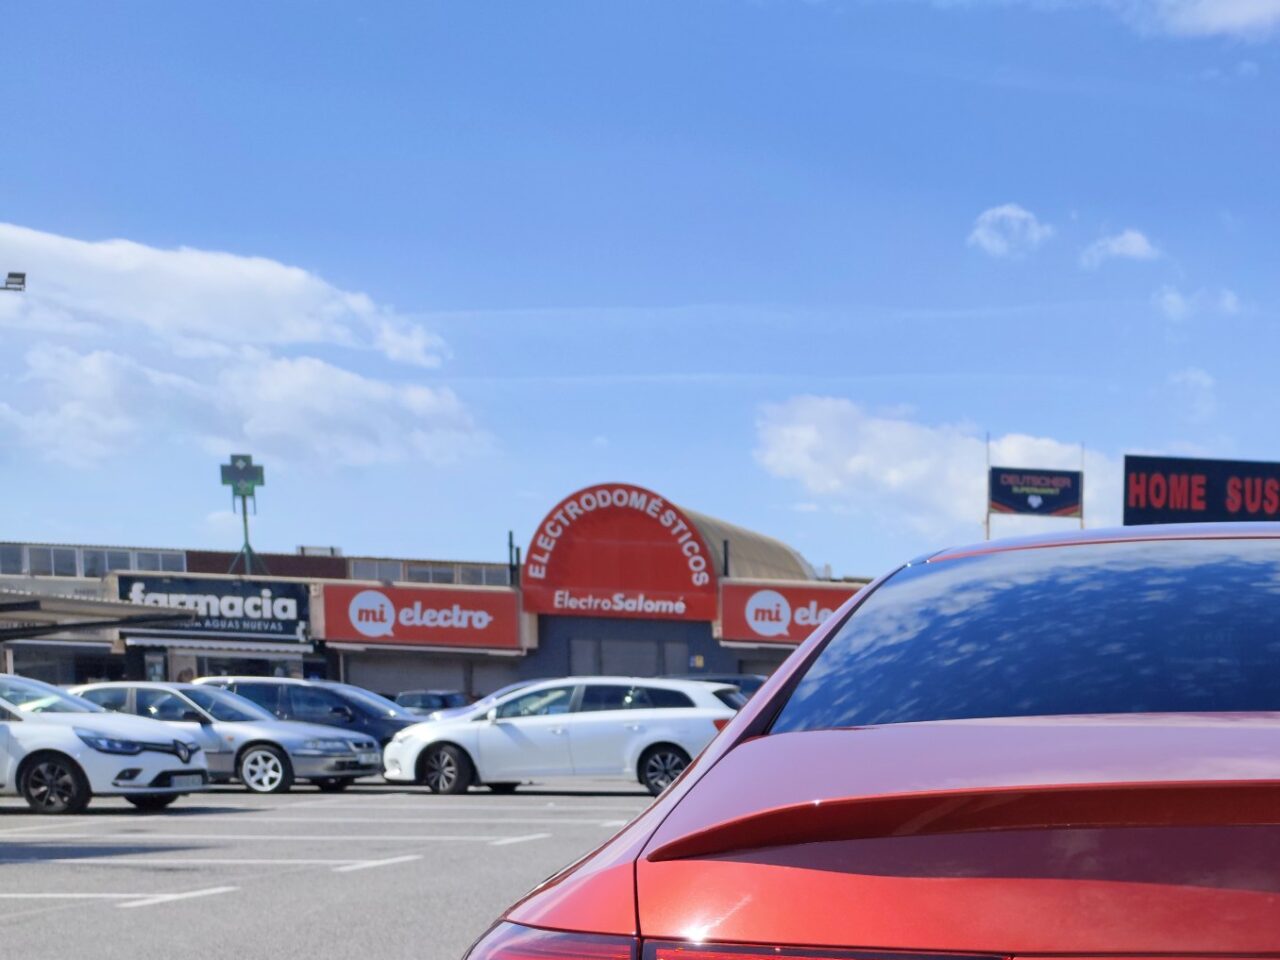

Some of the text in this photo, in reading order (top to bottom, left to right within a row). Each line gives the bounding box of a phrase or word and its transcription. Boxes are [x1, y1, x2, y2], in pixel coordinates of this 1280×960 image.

[1128, 472, 1206, 511] HOME
[528, 488, 709, 586] ELECTRODOMÉSTICOS
[129, 582, 297, 620] farmacia
[357, 601, 493, 629] mi electro
[553, 590, 687, 614] ElectroSalomé
[753, 603, 783, 622] mi
[204, 619, 240, 630] AGUAS
[242, 620, 283, 632] NUEVAS
